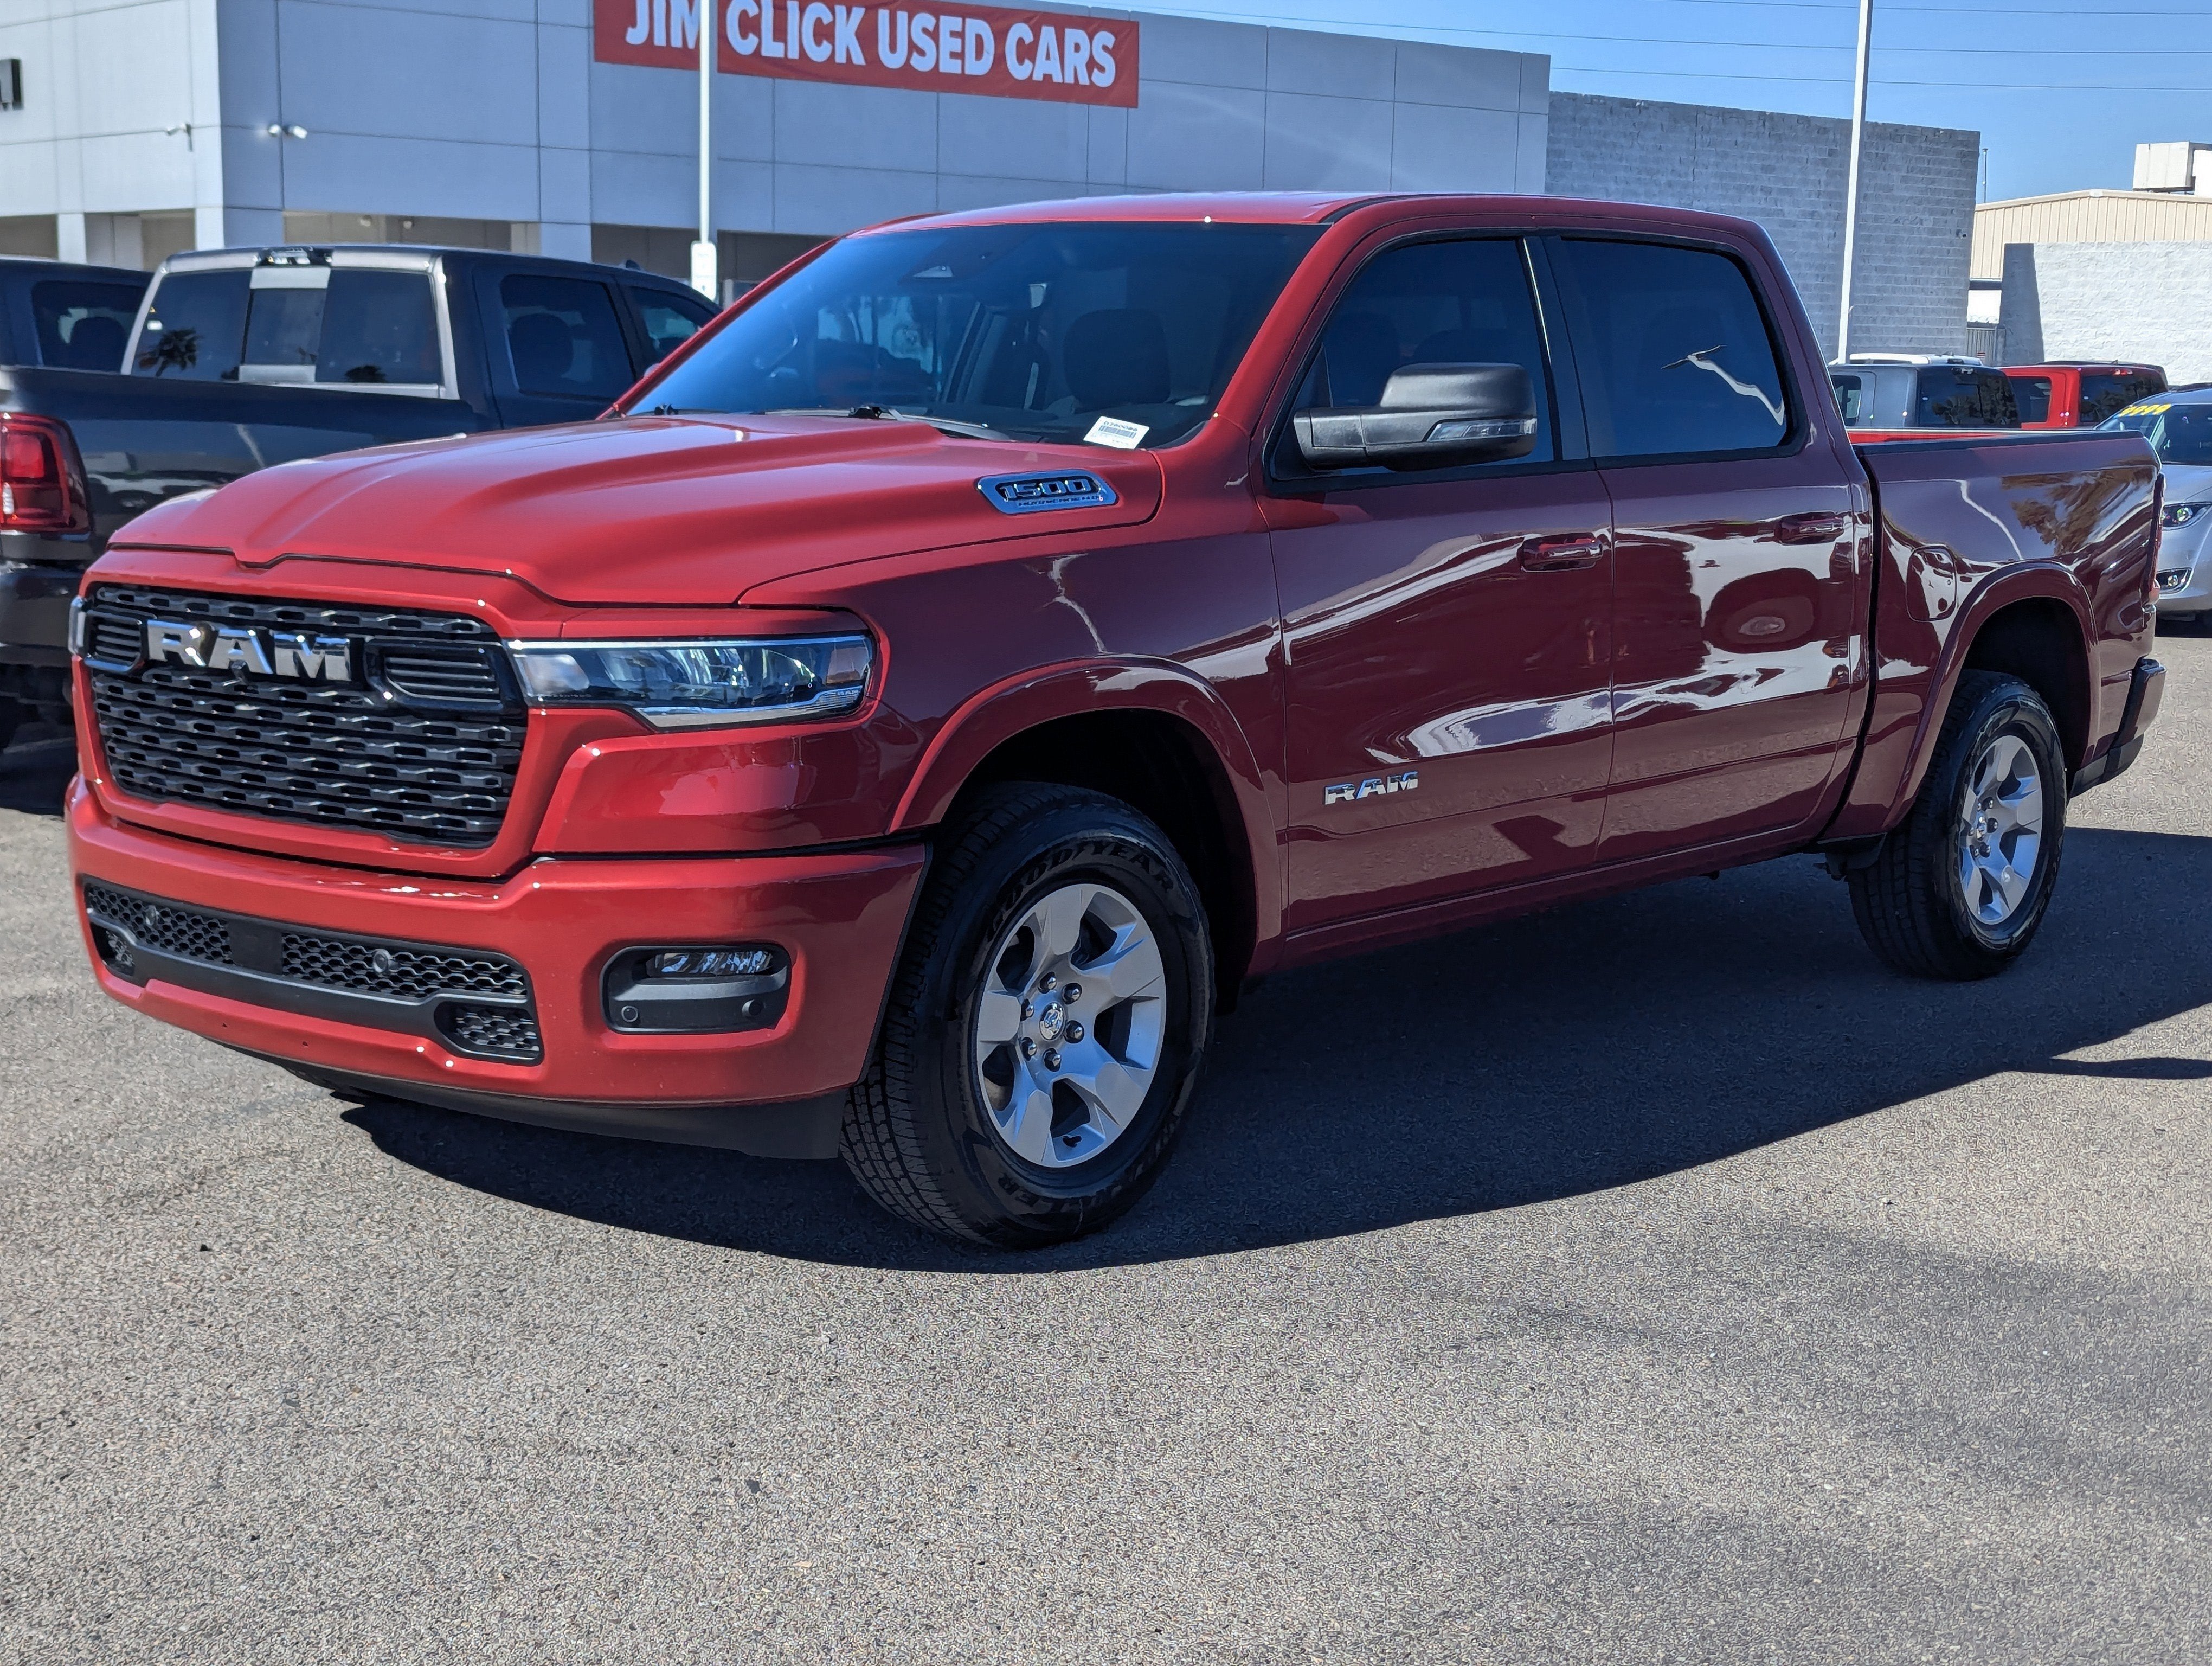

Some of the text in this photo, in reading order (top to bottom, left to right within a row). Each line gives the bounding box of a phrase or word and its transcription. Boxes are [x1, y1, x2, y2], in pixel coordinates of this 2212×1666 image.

[626, 0, 1116, 87] JIM CLICK USED CARS
[1000, 479, 1091, 501] 1500
[147, 619, 351, 681] RAM
[1324, 770, 1418, 805] RAM
[992, 839, 1174, 934] GOODYEAR
